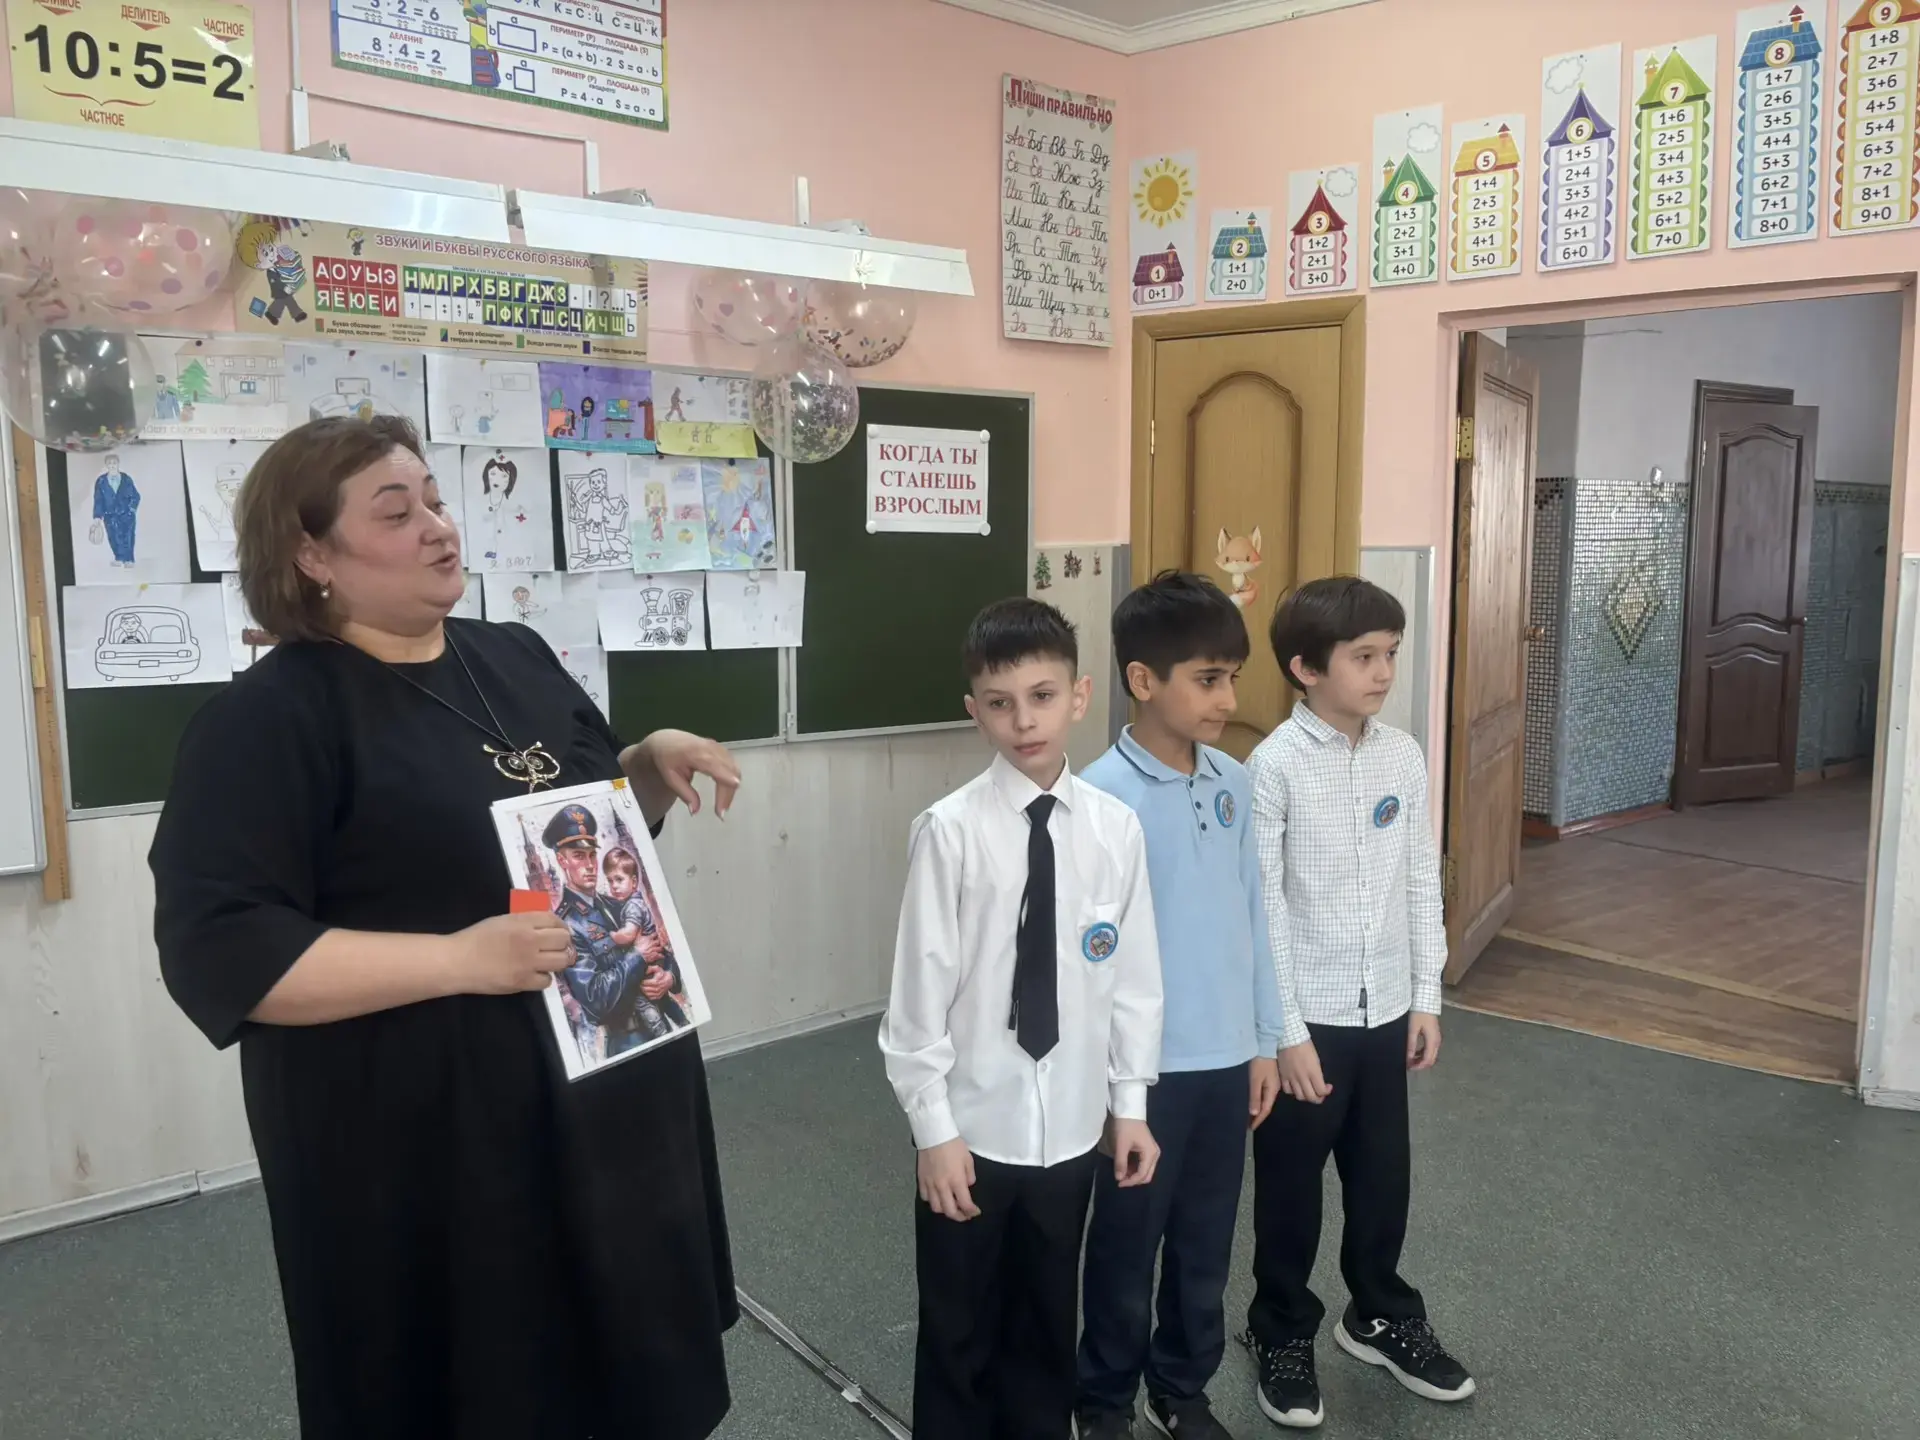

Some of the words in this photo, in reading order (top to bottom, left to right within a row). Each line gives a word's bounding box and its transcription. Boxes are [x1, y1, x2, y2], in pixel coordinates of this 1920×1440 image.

[121, 5, 170, 25] ДЕЛИТЕЛЬ
[1881, 7, 1891, 20] 9
[203, 18, 244, 37] ЧАСТНОЕ
[550, 25, 585, 38] ПЕРИМЕТР
[389, 31, 423, 45] ДЕЛЕНИЕ
[606, 38, 638, 52] ПЛОЩАДЬ
[1869, 30, 1899, 47] 1+8
[1775, 48, 1784, 60] 8
[1867, 52, 1898, 70] 2+7
[552, 67, 586, 80] ПЕРИМЕТР
[1765, 70, 1793, 86] 1+7
[606, 79, 639, 92] ПЛОЩАДЬ
[1867, 74, 1898, 92] 3+6
[1671, 87, 1679, 99] 7
[1764, 91, 1792, 107] 2+6
[1866, 97, 1897, 113] 4+5
[80, 109, 125, 126] ЧАСТНОЕ
[1660, 109, 1685, 125] 1+6
[1763, 112, 1792, 128] 3+5
[1576, 125, 1584, 137] 6
[1865, 119, 1895, 135] 5+4
[1658, 130, 1685, 145] 2+5
[1762, 134, 1791, 149] 4+4
[1567, 146, 1591, 161] 1+5
[1863, 141, 1894, 157] 6+3
[1482, 156, 1490, 167] 5
[1658, 150, 1684, 166] 3+4
[1762, 155, 1790, 170] 5+3
[1565, 166, 1590, 182] 2+4
[1657, 170, 1684, 186] 4+3
[1863, 163, 1893, 180] 7+2
[1474, 177, 1497, 191] 1+4
[1761, 176, 1789, 191] 6+2
[1402, 188, 1409, 198] 4
[1565, 186, 1590, 201] 3+3
[1657, 191, 1683, 206] 5+2
[1861, 185, 1889, 201] 8+1
[1473, 195, 1497, 210] 2+3
[1761, 197, 1788, 212] 7+1
[1395, 208, 1416, 221] 1+3
[1564, 206, 1589, 221] 4+2
[1655, 212, 1681, 226] 6+1
[1860, 206, 1892, 223] 9+0
[1316, 217, 1323, 229] 3
[1473, 215, 1496, 229] 3+2
[1760, 218, 1788, 233] 8+0
[1394, 227, 1415, 239] 2+2
[1473, 234, 1494, 247] 4+1
[1564, 226, 1587, 240] 5+1
[1655, 232, 1682, 247] 7+0
[1237, 243, 1243, 254] 2
[1308, 236, 1329, 249] 1+2
[376, 235, 418, 250] ЗВУКИ
[422, 240, 431, 250] И
[435, 242, 479, 256] БУКВЫ
[483, 247, 546, 264] РУССКОГО
[550, 255, 591, 268] ЯЗЫКА
[1394, 245, 1414, 258] 3+1
[1563, 246, 1588, 260] 6+0
[1307, 255, 1328, 268] 2+1
[1472, 253, 1495, 267] 5+0
[1155, 268, 1161, 280] 1
[1228, 262, 1247, 274] 1+1
[1393, 263, 1415, 275] 4+0
[1226, 280, 1247, 291] 2+0
[1307, 273, 1328, 285] 3+0
[1148, 288, 1167, 300] 0+1
[879, 443, 944, 466] КОГДА
[949, 447, 977, 465] ТЫ
[880, 469, 976, 490] СТАНЕШЬ
[874, 496, 982, 515] ВЗРОСЛЫМ
